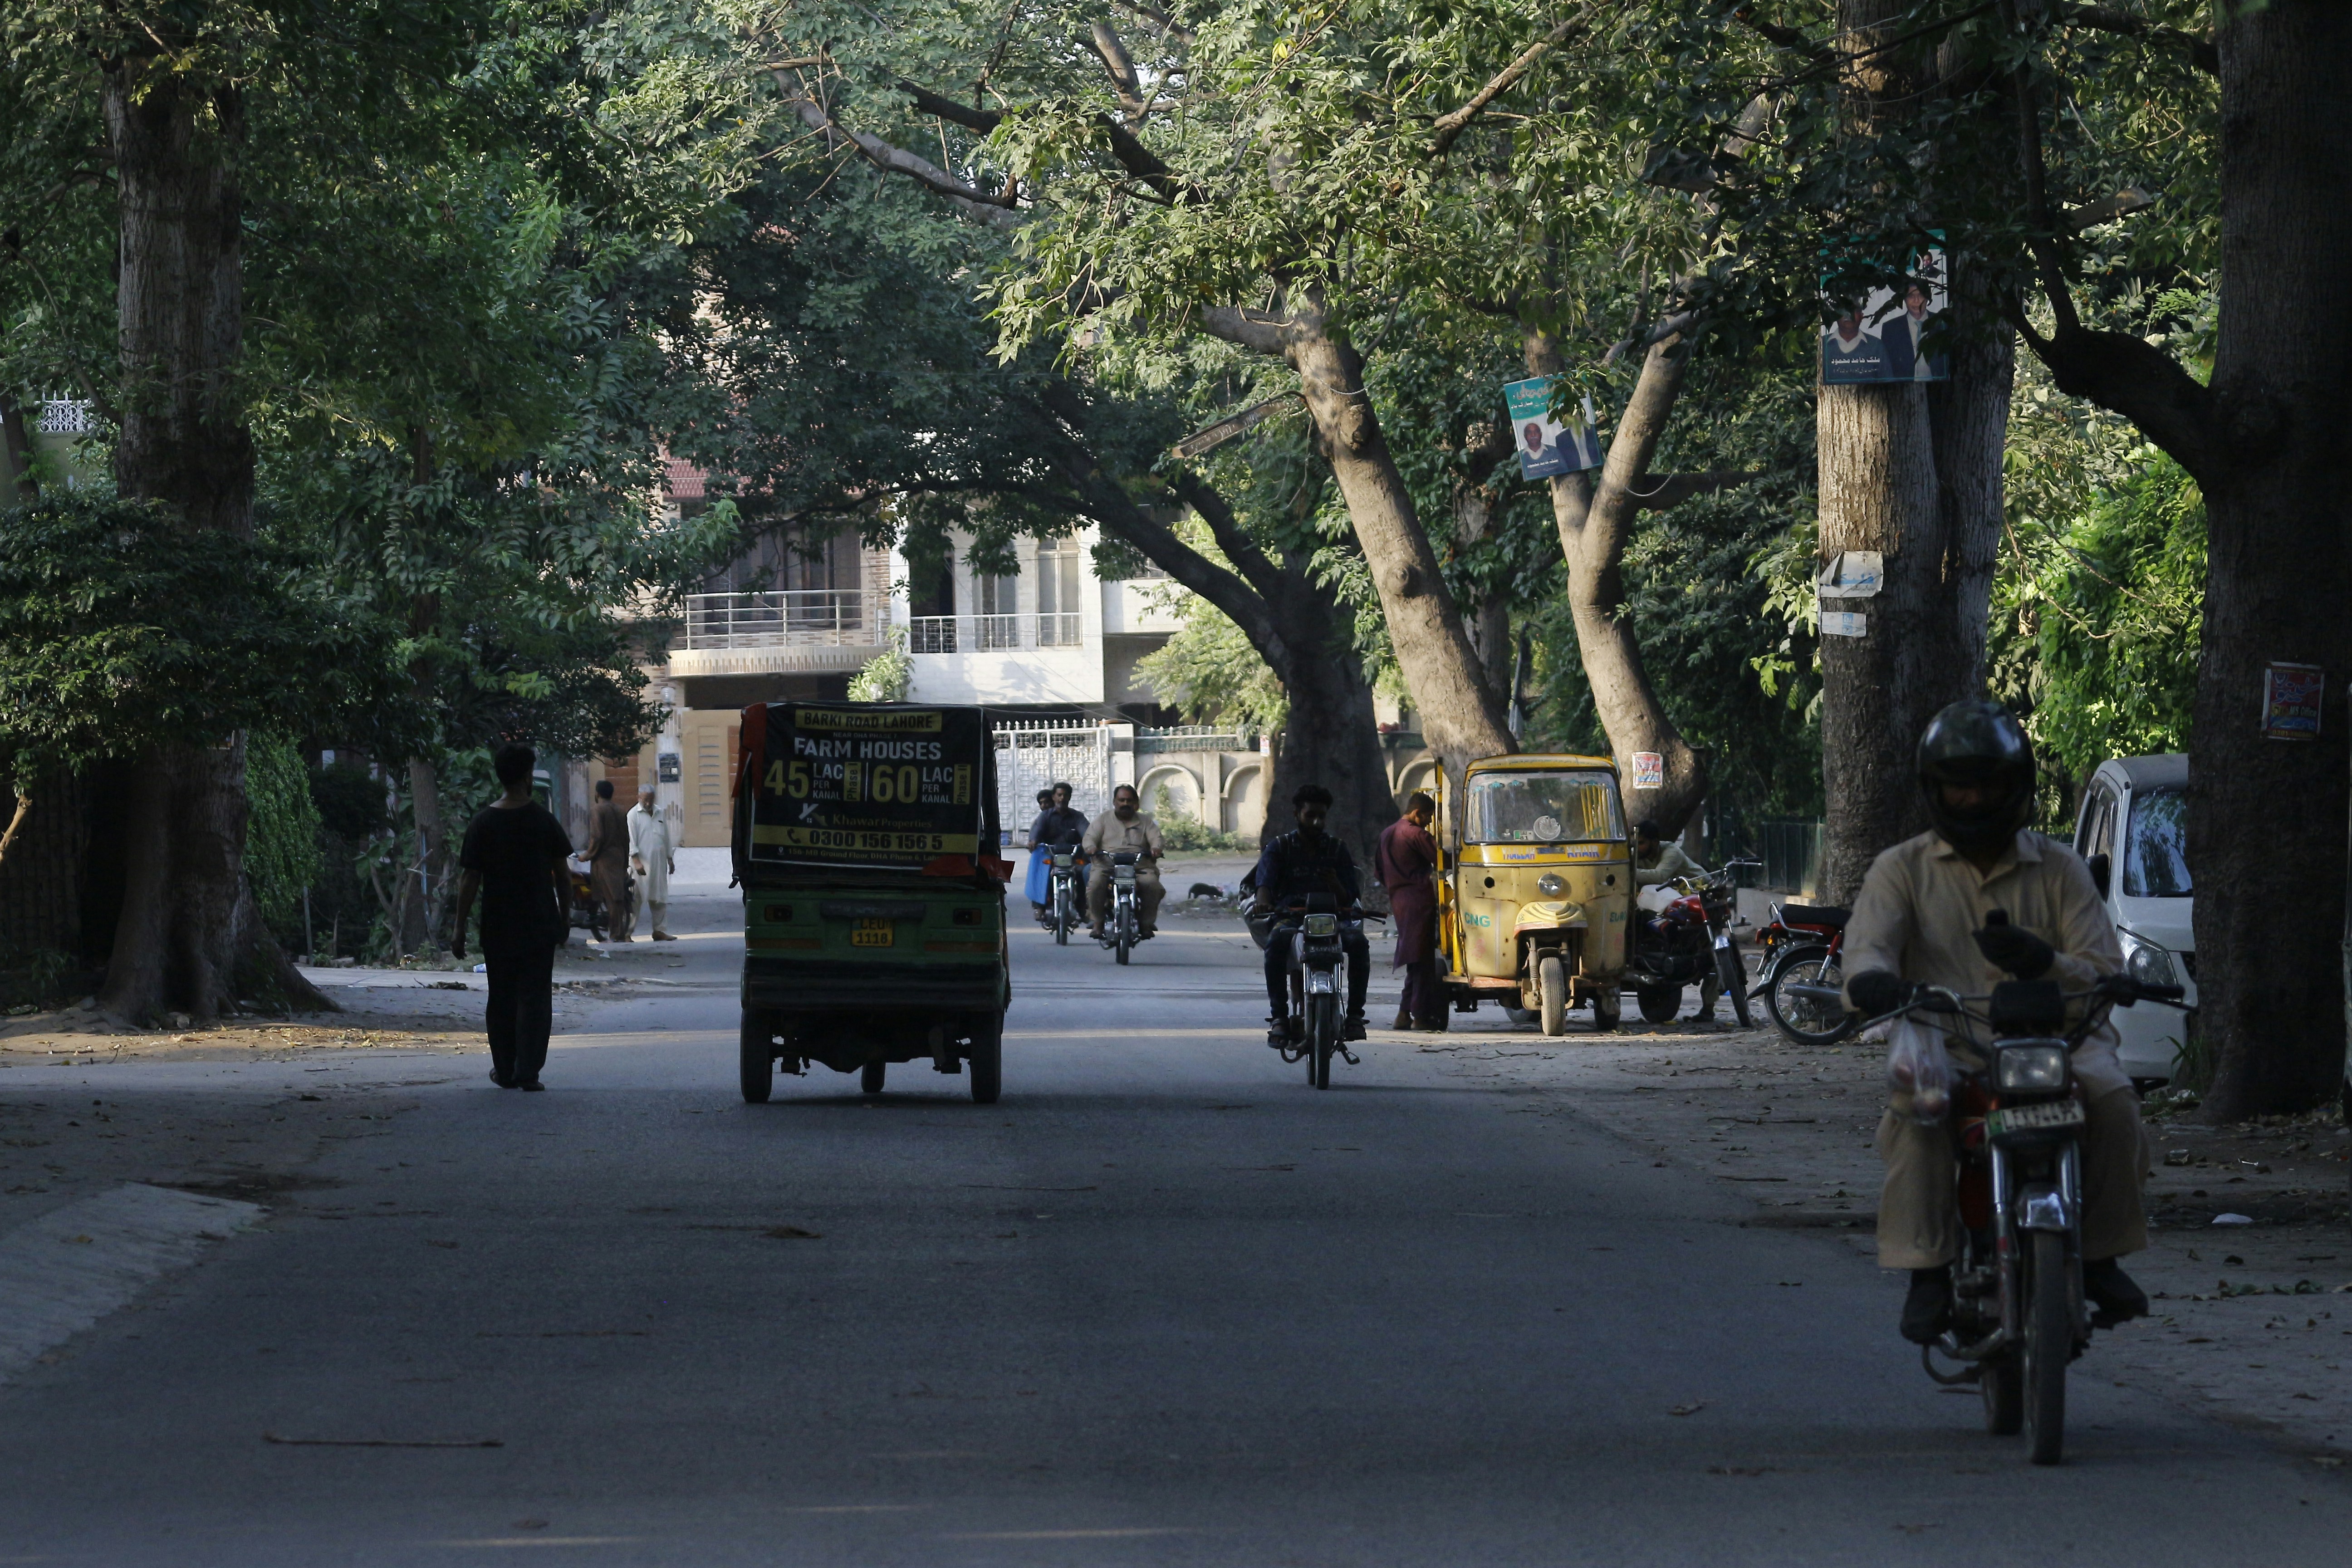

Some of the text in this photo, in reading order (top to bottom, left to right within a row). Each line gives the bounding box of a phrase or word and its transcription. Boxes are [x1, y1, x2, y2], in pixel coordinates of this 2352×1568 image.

[804, 712, 933, 729] BARKI ROAD LAHORE
[794, 736, 941, 760] FARM HOUSES
[764, 759, 809, 799] 45
[813, 762, 843, 780] LAC
[922, 766, 953, 783] LAC
[813, 780, 830, 789] PER
[847, 769, 858, 800] Phase
[872, 764, 919, 804] 60
[922, 784, 940, 793] PER
[956, 774, 967, 804] Phase
[813, 789, 841, 800] KANAL
[921, 794, 951, 804] KANAL
[833, 813, 932, 830] Khawar Properties
[809, 829, 943, 850] 0300 156 156 5
[820, 850, 847, 858] Ground
[1465, 911, 1491, 927] CNG
